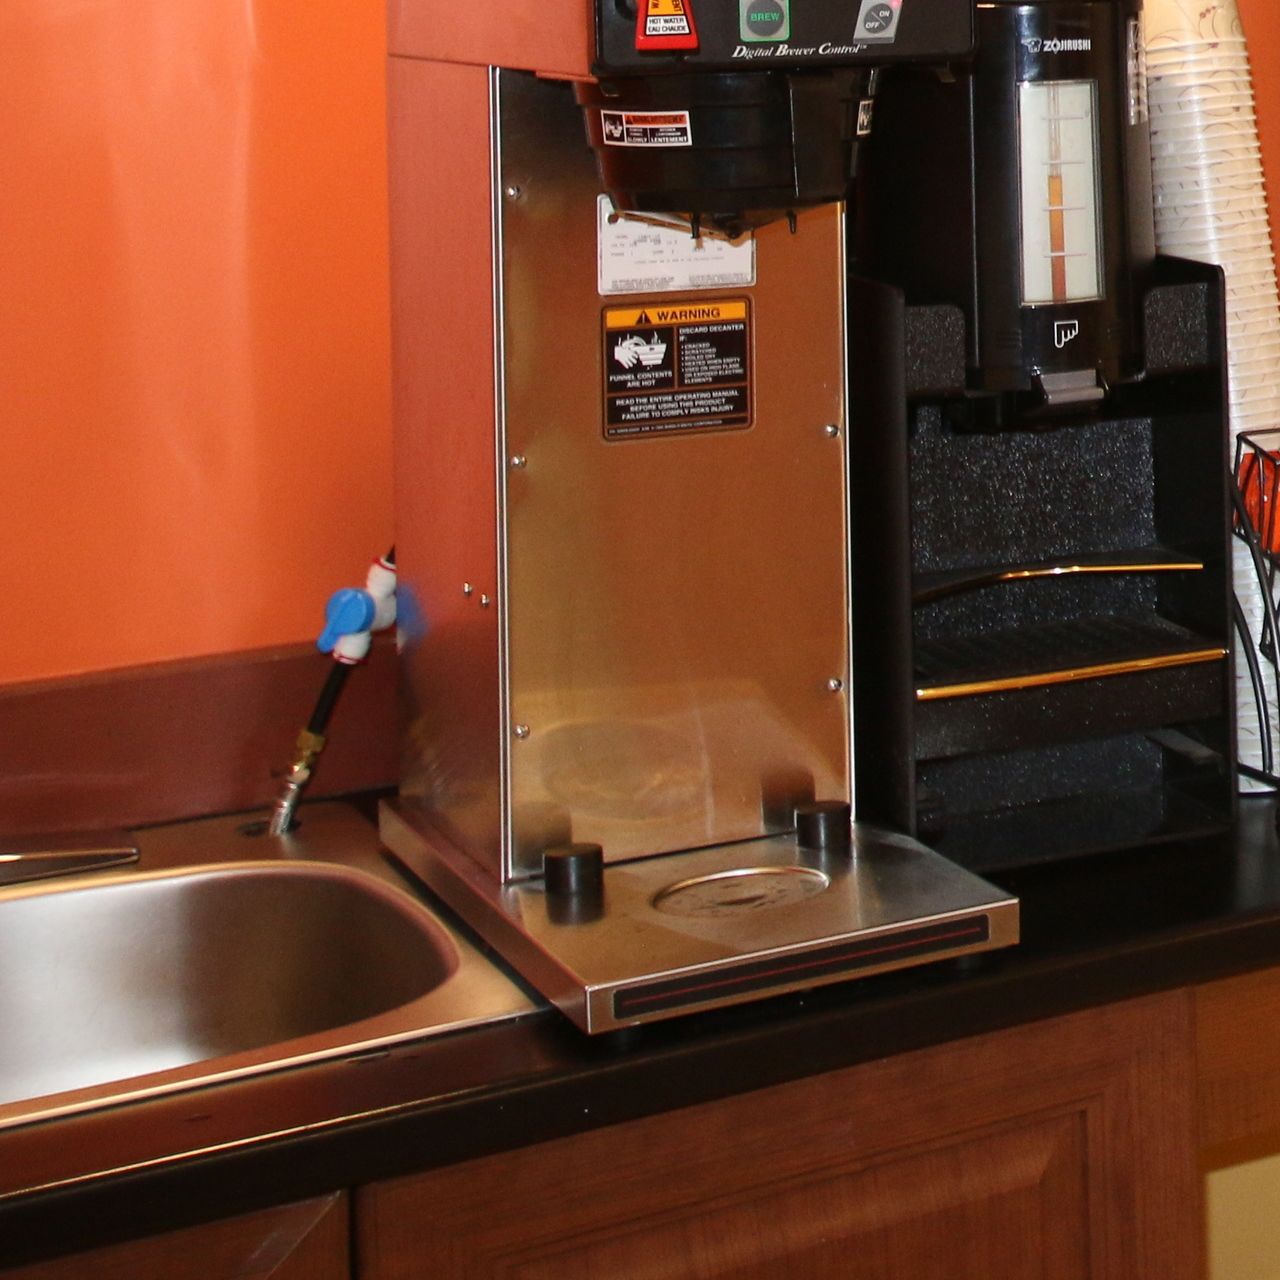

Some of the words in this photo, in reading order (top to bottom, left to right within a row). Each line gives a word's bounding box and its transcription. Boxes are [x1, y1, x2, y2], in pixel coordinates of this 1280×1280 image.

[751, 12, 780, 22] BREW
[879, 10, 890, 18] ON
[865, 21, 880, 29] OFF
[731, 45, 773, 59] Digital
[775, 43, 815, 57] Brewer
[1043, 37, 1091, 54] ZOJIRUSHI
[657, 307, 721, 321] WARNING
[679, 326, 708, 334] DISCARD
[709, 323, 745, 332] DECANTER
[609, 372, 636, 382] FUNNEL
[637, 370, 673, 380] CONTENTS
[626, 380, 641, 389] ARE
[641, 379, 656, 387] HOT
[616, 398, 635, 406] READ
[649, 395, 673, 403] ENTIRE
[674, 391, 711, 401] OPERATING
[712, 389, 740, 397] MANUAL
[630, 404, 656, 412] BEFORE
[657, 402, 678, 410] USING
[695, 398, 725, 407] PRODUCT
[622, 412, 650, 420] FAILURE
[651, 410, 661, 418] TO
[661, 408, 689, 417] COMPLY
[690, 407, 710, 415] RISKS
[710, 405, 734, 413] INJURY
